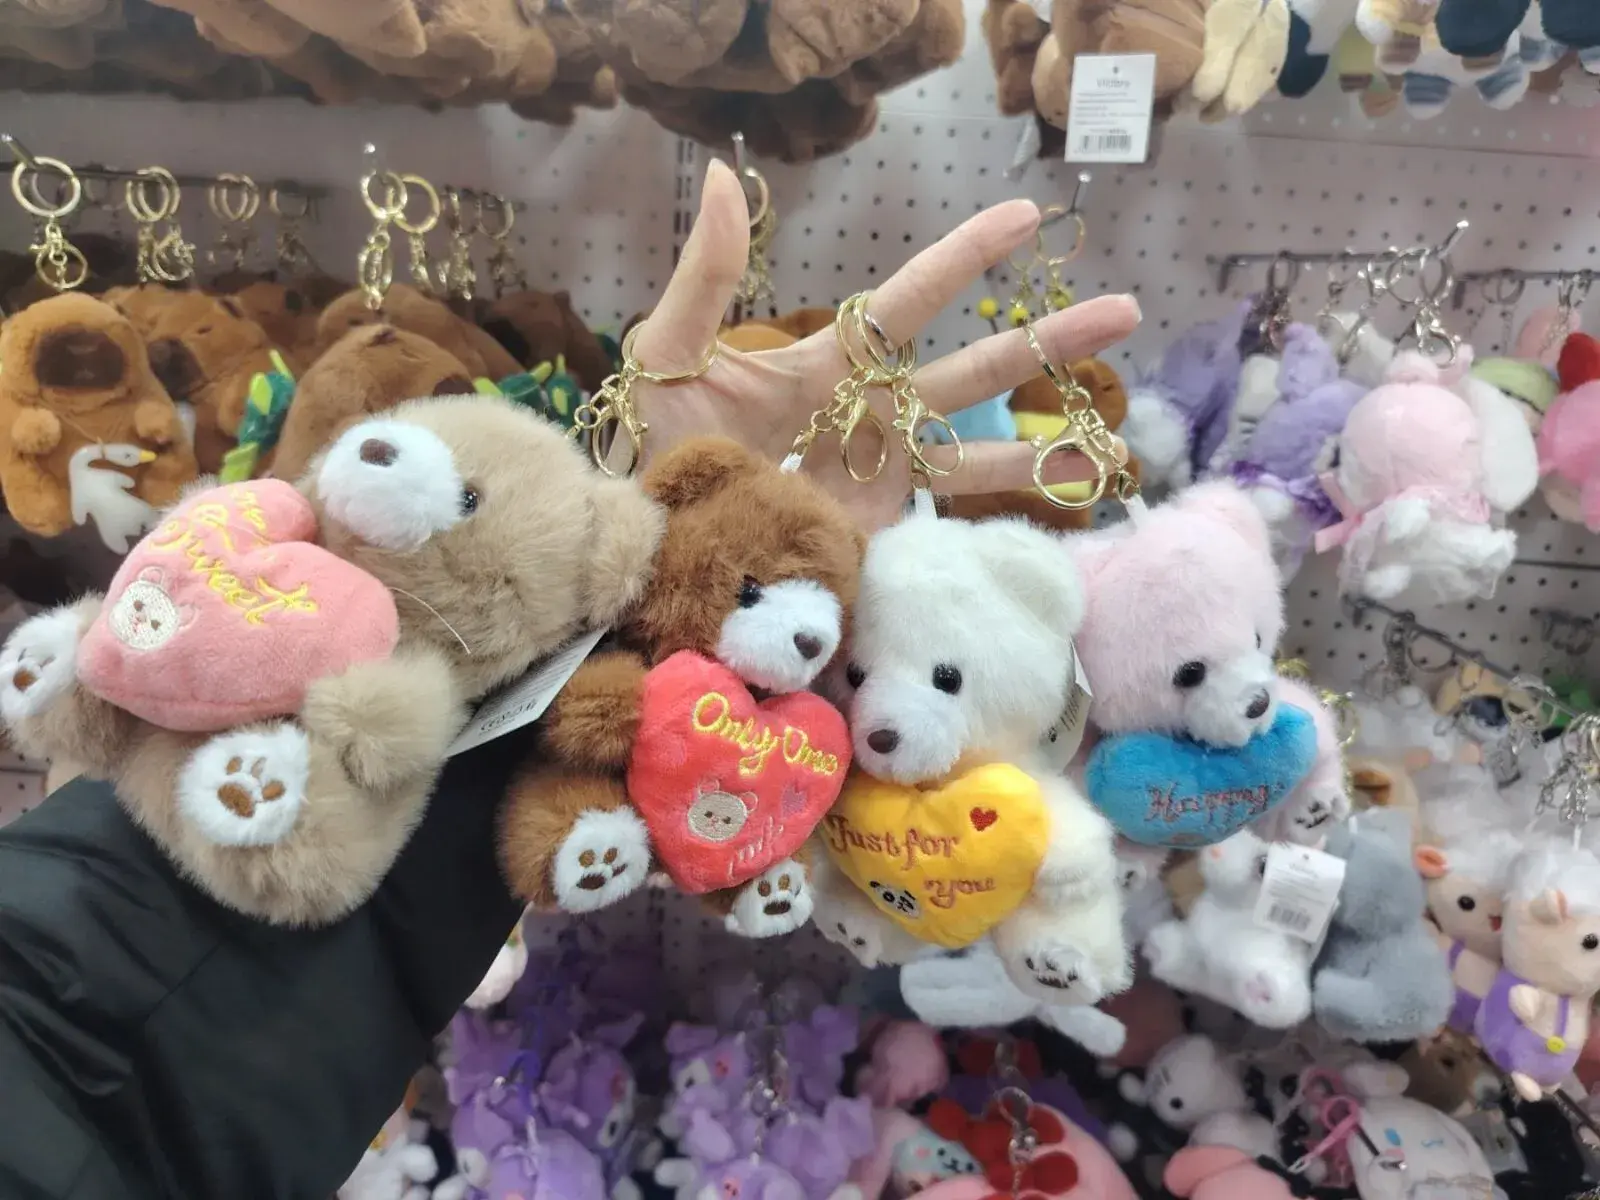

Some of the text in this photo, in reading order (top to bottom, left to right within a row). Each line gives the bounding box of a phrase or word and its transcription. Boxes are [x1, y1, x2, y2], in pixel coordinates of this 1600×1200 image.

[692, 691, 839, 777] Only One
[1144, 782, 1269, 824] Happy
[824, 813, 900, 857] Just
[901, 827, 960, 871] for
